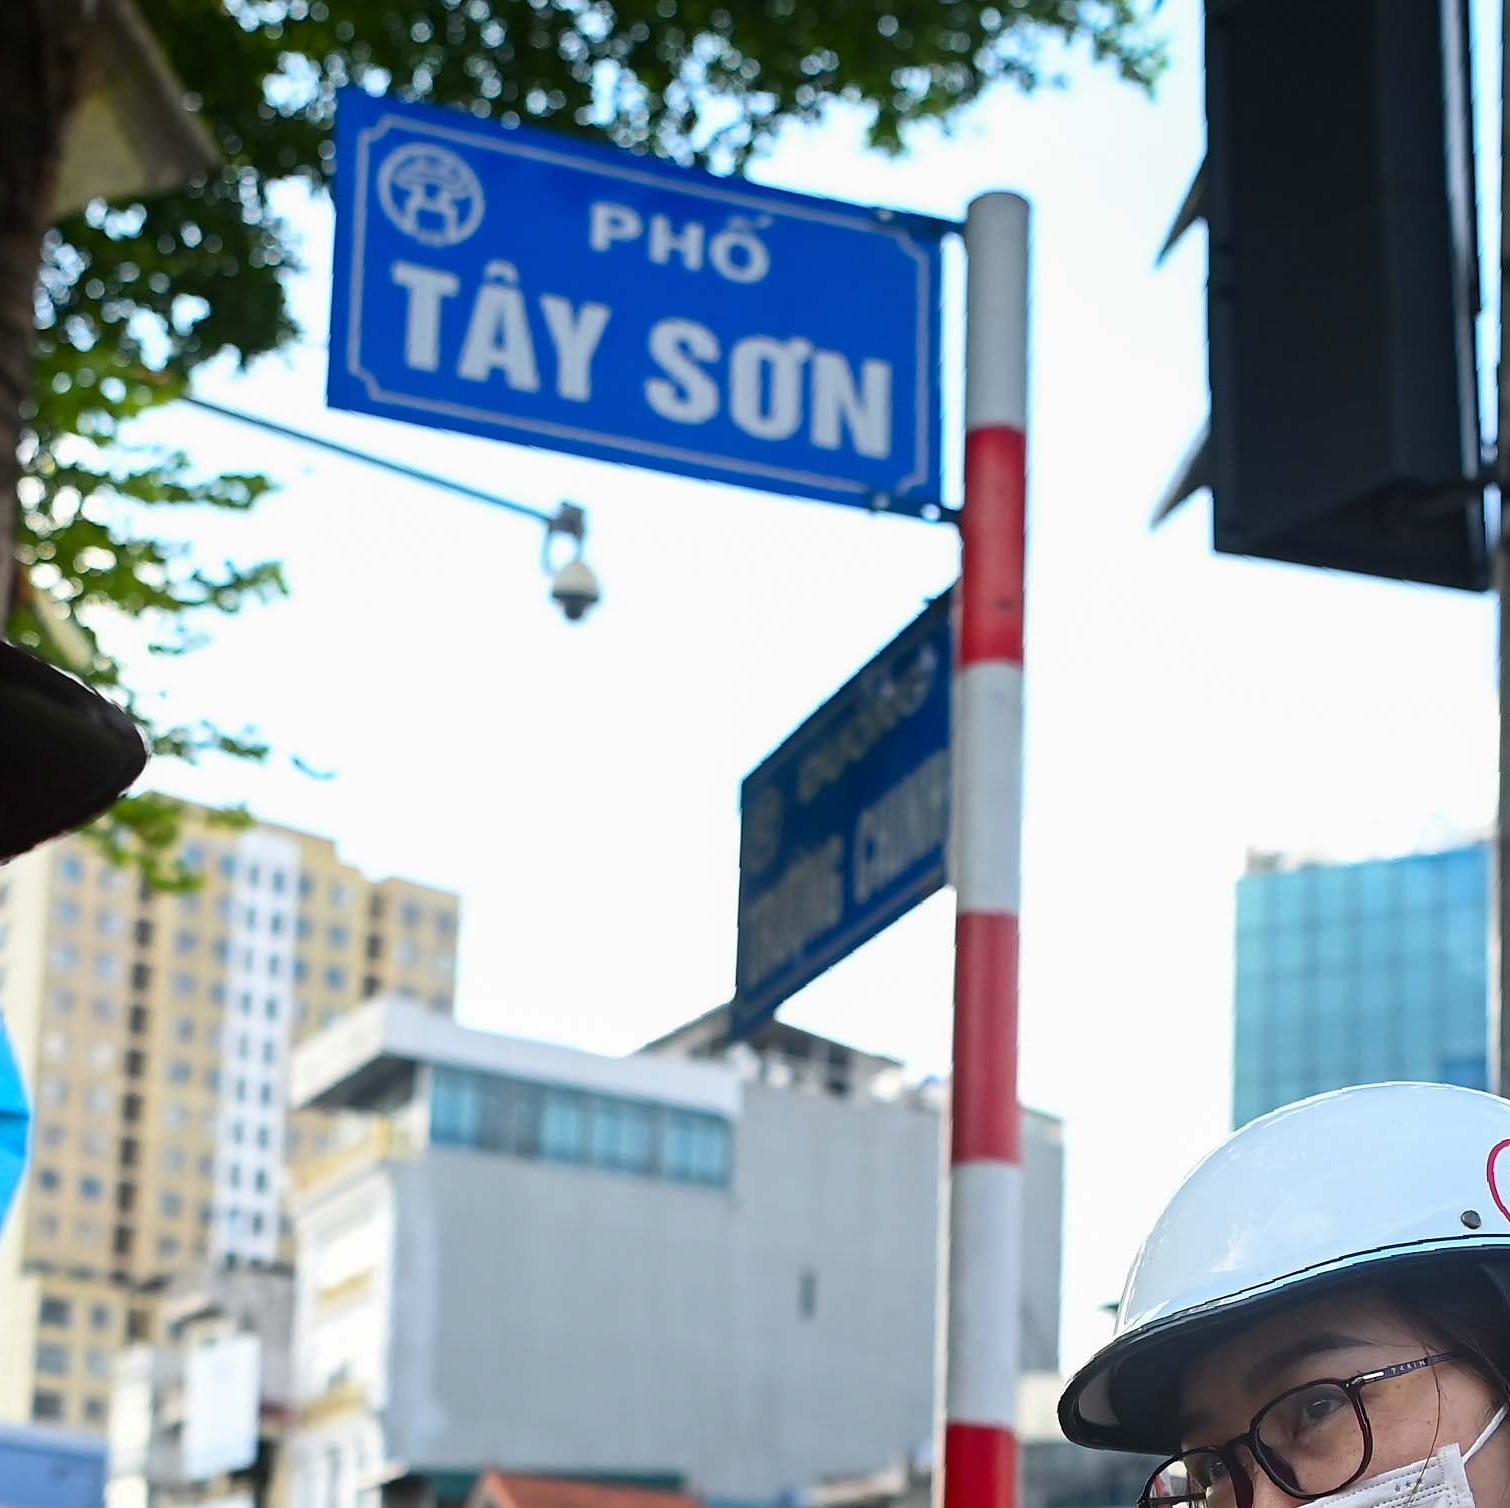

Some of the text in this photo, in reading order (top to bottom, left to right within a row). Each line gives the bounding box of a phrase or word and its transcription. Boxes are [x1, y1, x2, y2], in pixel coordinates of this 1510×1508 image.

[590, 205, 774, 284] PHỐ
[391, 260, 891, 459] TÂY SƠN
